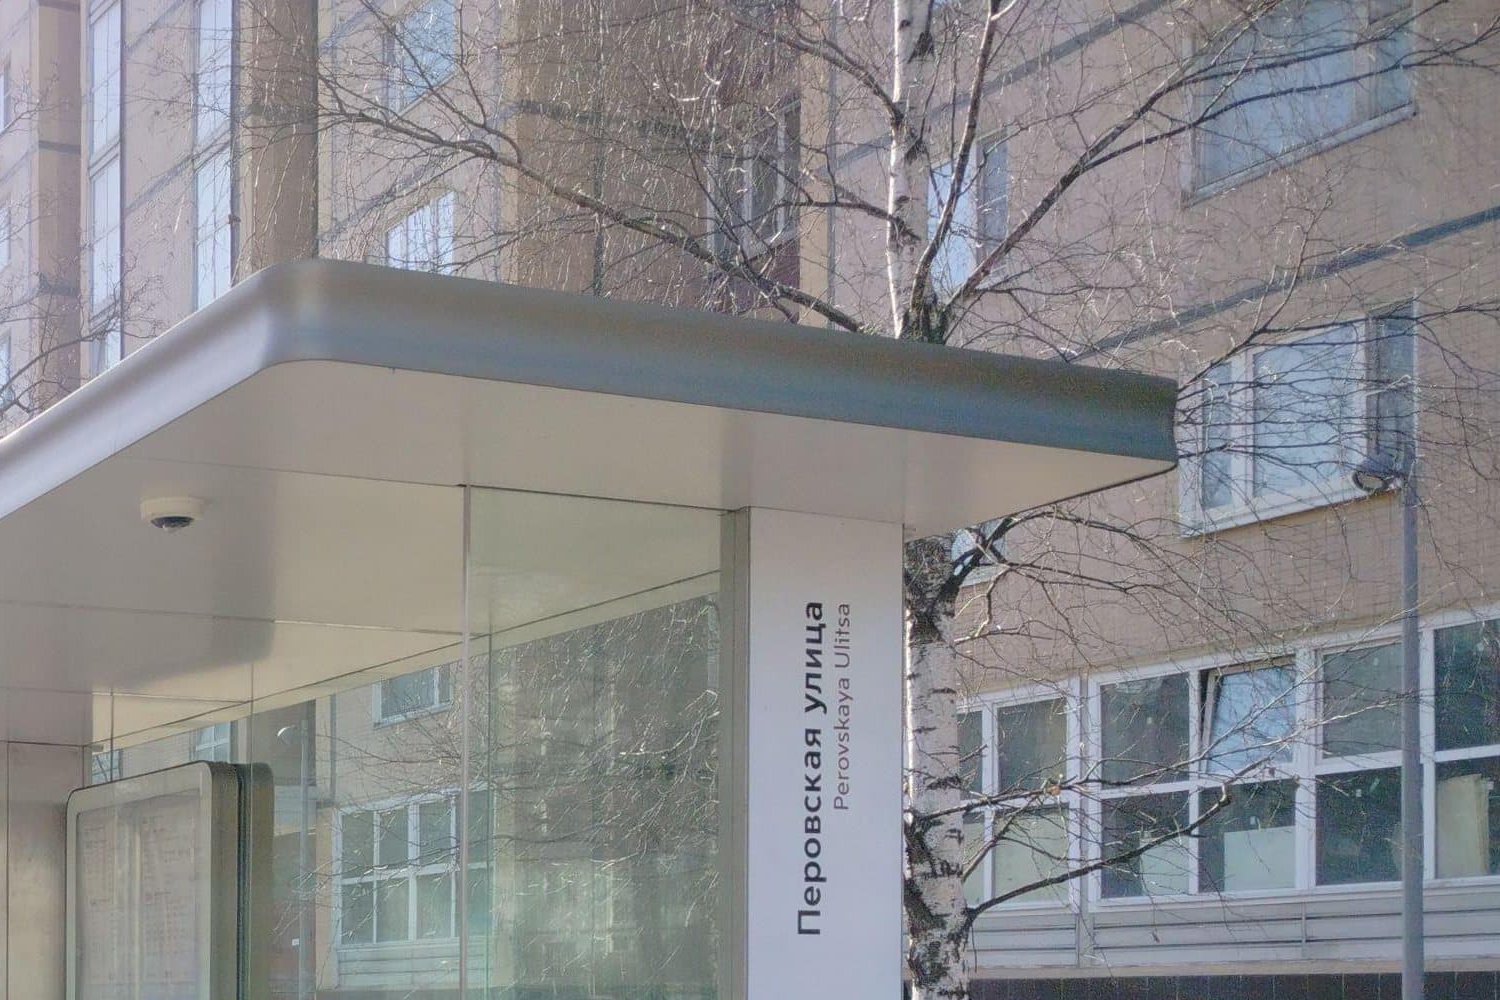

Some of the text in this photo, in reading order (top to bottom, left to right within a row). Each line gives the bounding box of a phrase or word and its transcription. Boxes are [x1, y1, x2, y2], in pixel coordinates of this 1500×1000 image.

[797, 601, 828, 936] Перовская улица
[833, 603, 853, 811] Perovskaya Ulitsa
